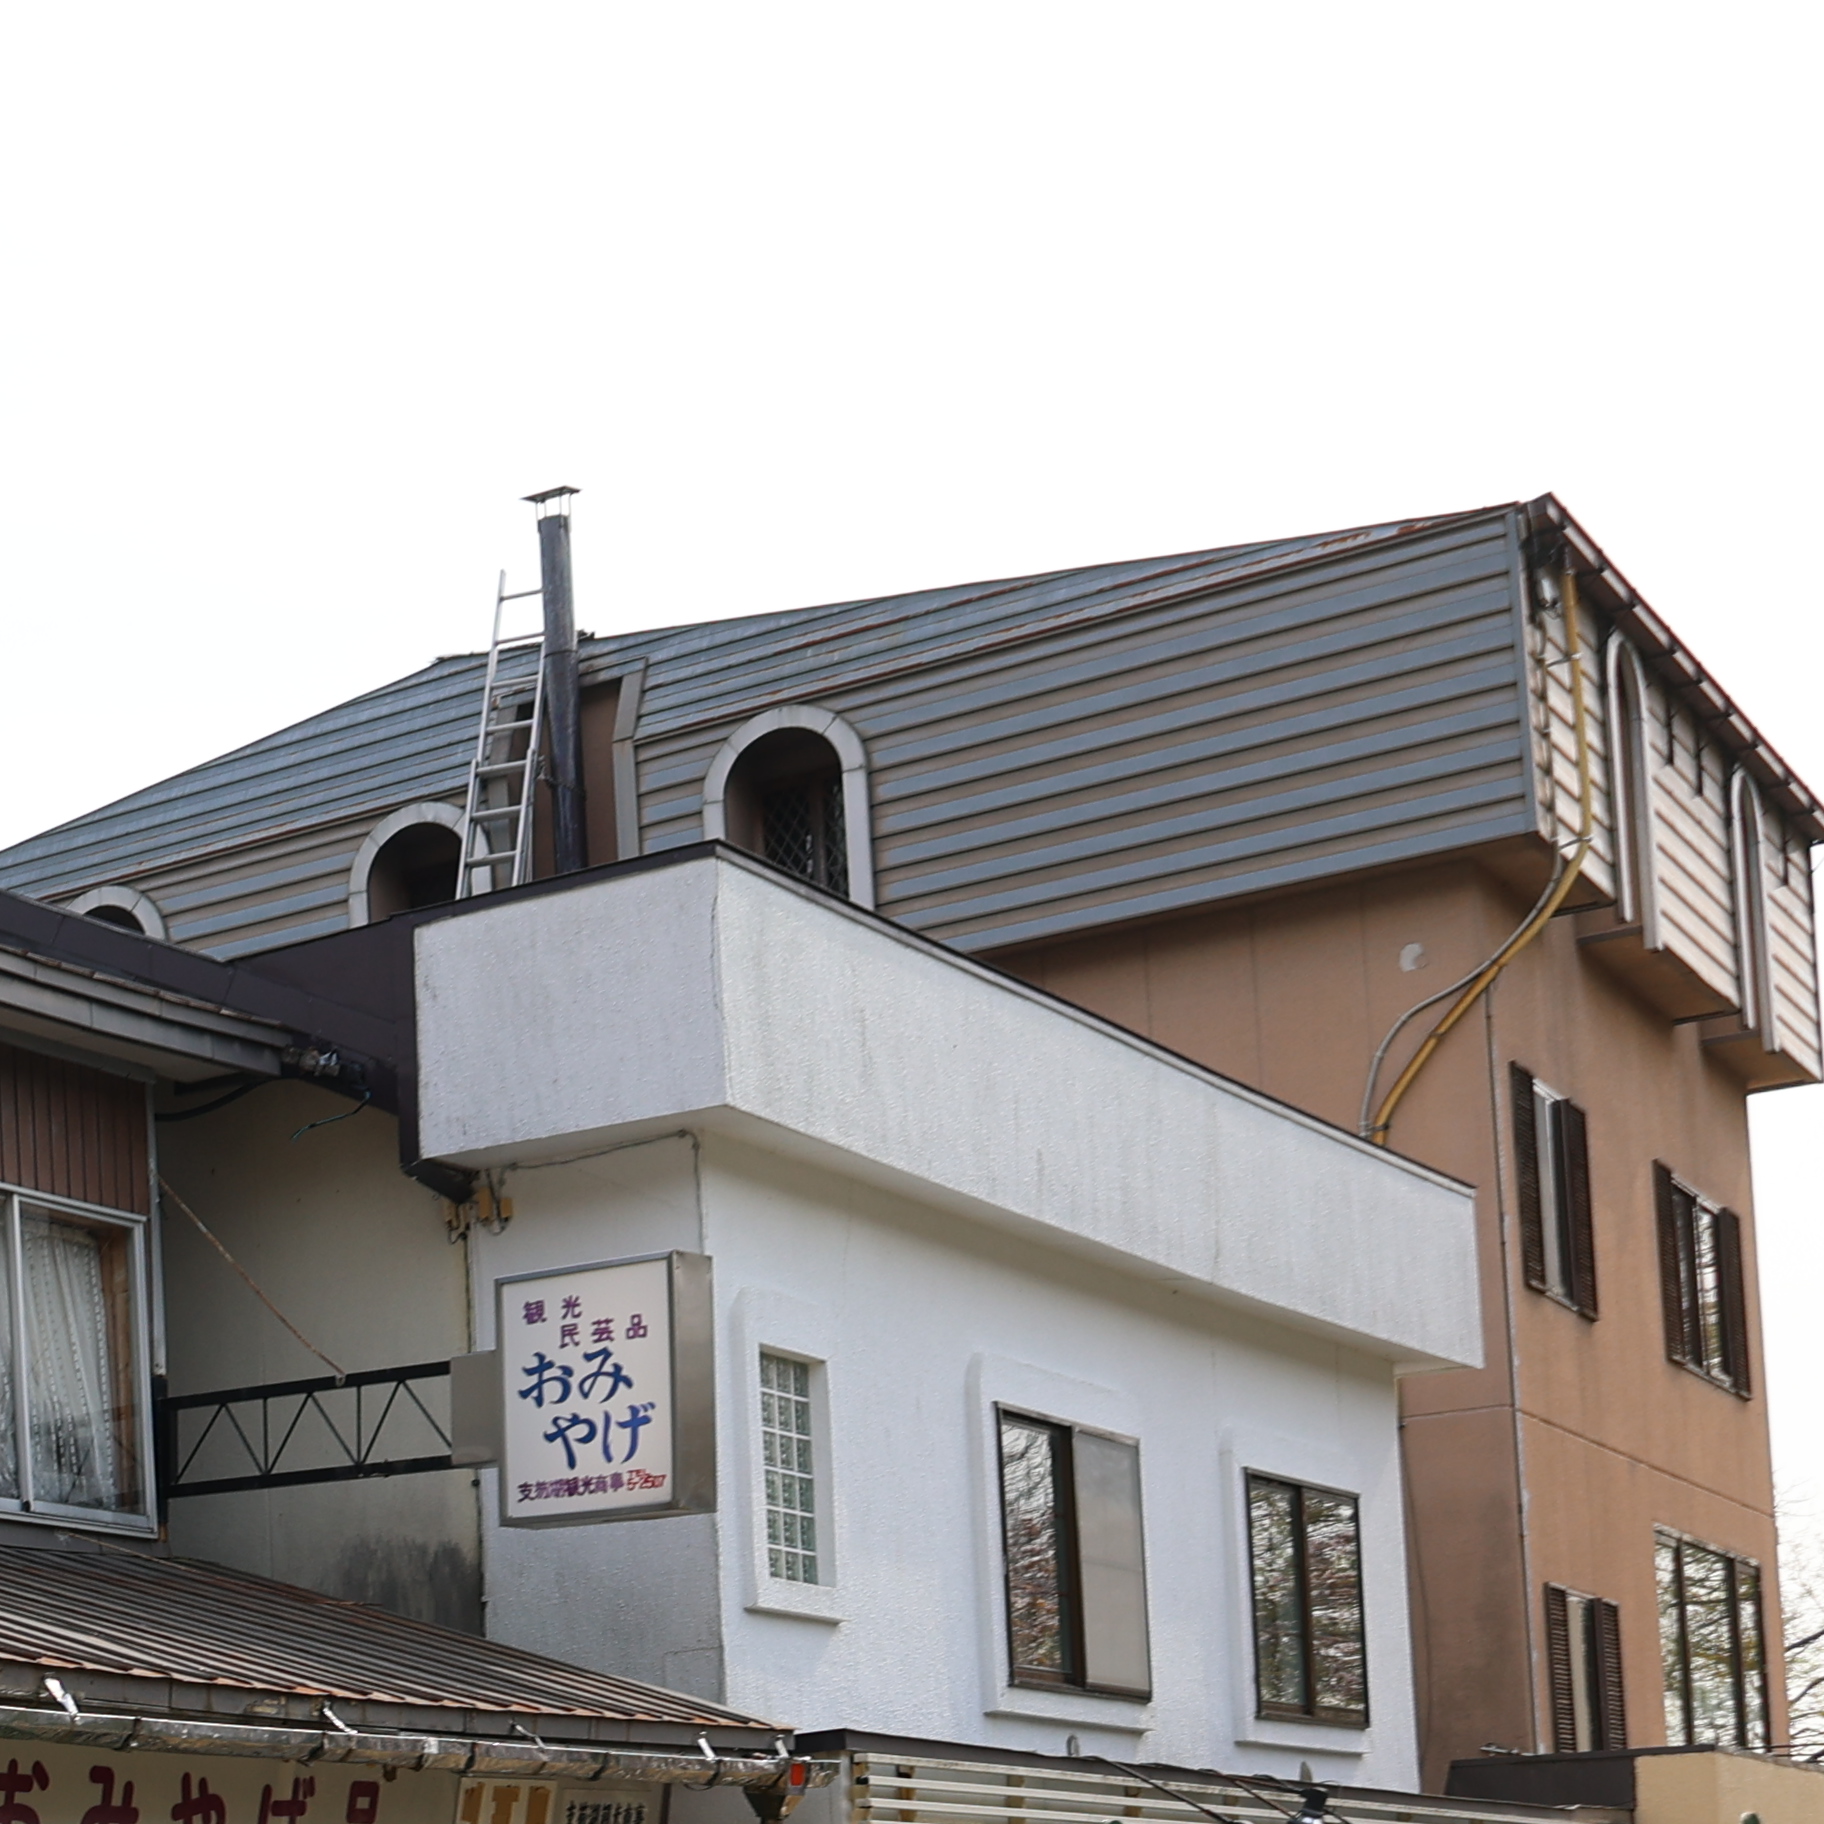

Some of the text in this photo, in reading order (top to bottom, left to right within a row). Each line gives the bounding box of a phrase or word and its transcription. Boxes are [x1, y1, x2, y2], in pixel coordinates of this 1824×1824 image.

[523, 1295, 582, 1325] 観光
[559, 1314, 648, 1349] 民芸品
